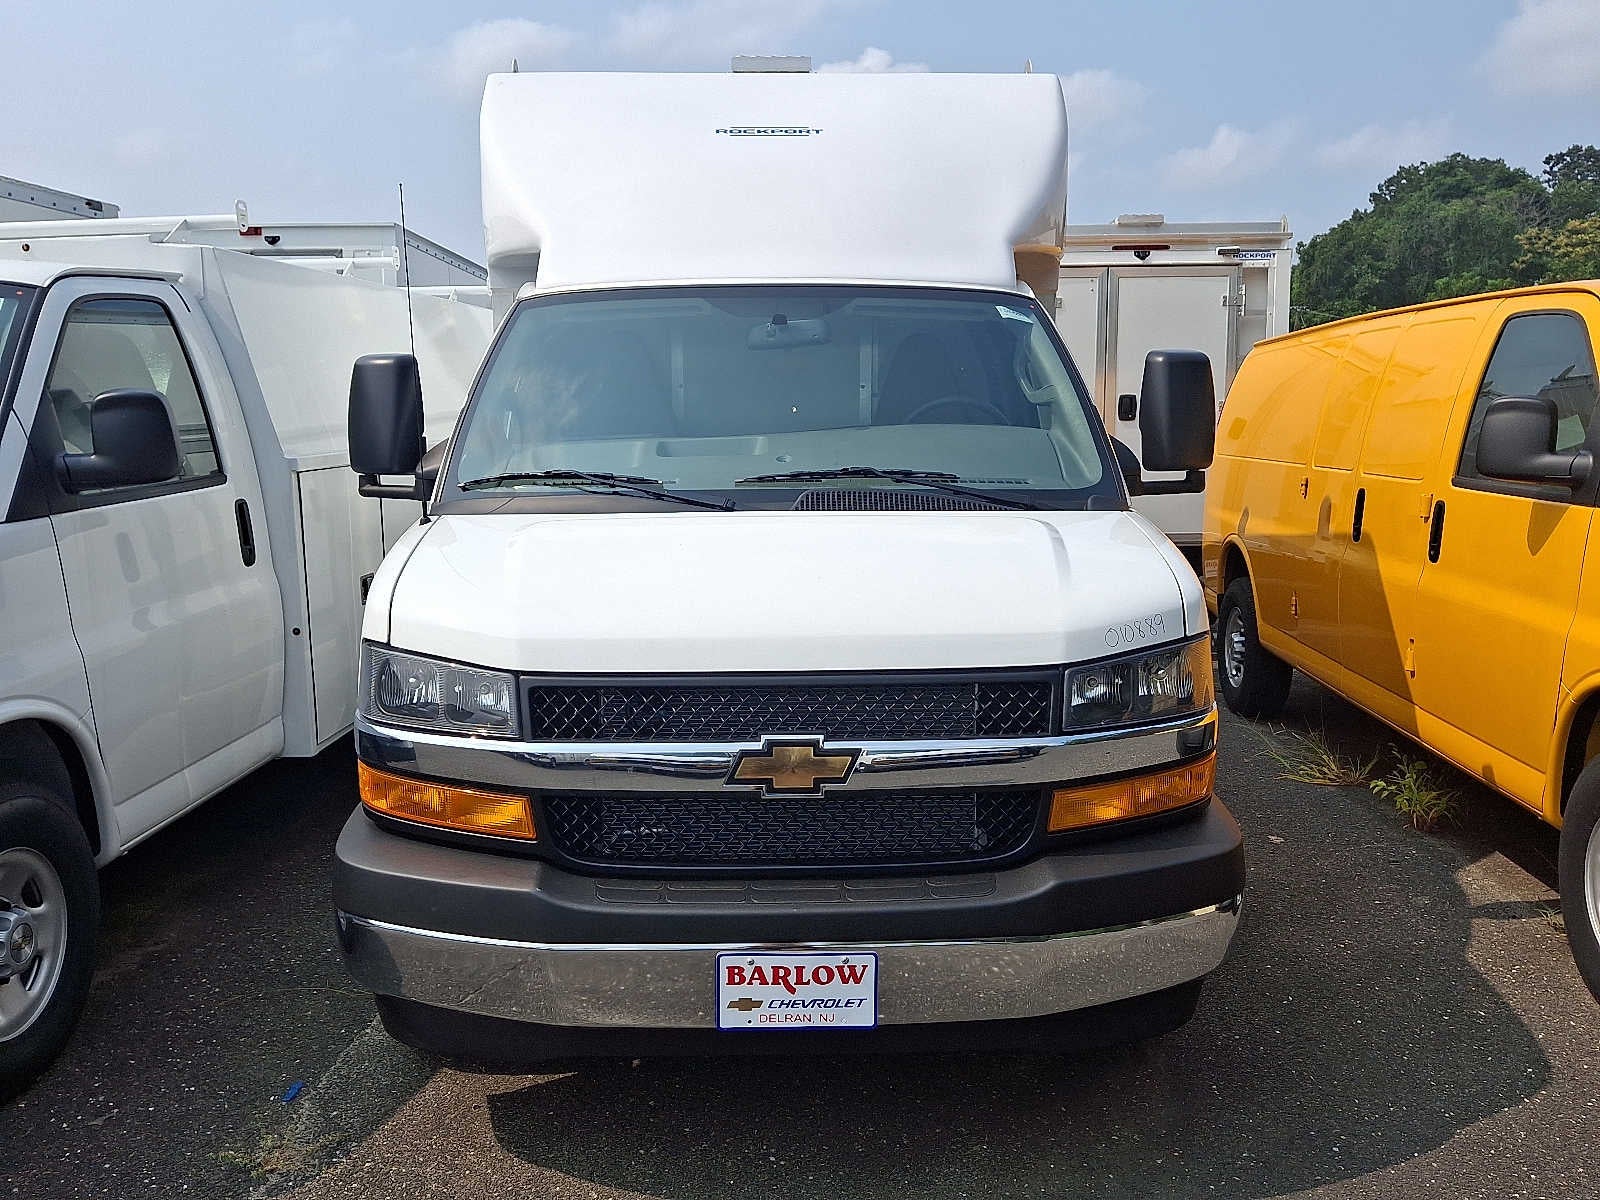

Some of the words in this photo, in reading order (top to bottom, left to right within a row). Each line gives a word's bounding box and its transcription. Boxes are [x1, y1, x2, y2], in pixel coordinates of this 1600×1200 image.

[1105, 613, 1165, 647] 010889
[726, 965, 869, 995] BARLOW
[767, 998, 868, 1009] CHEVROLET
[759, 1014, 815, 1024] DELRAN,
[819, 1014, 836, 1023] NJ
